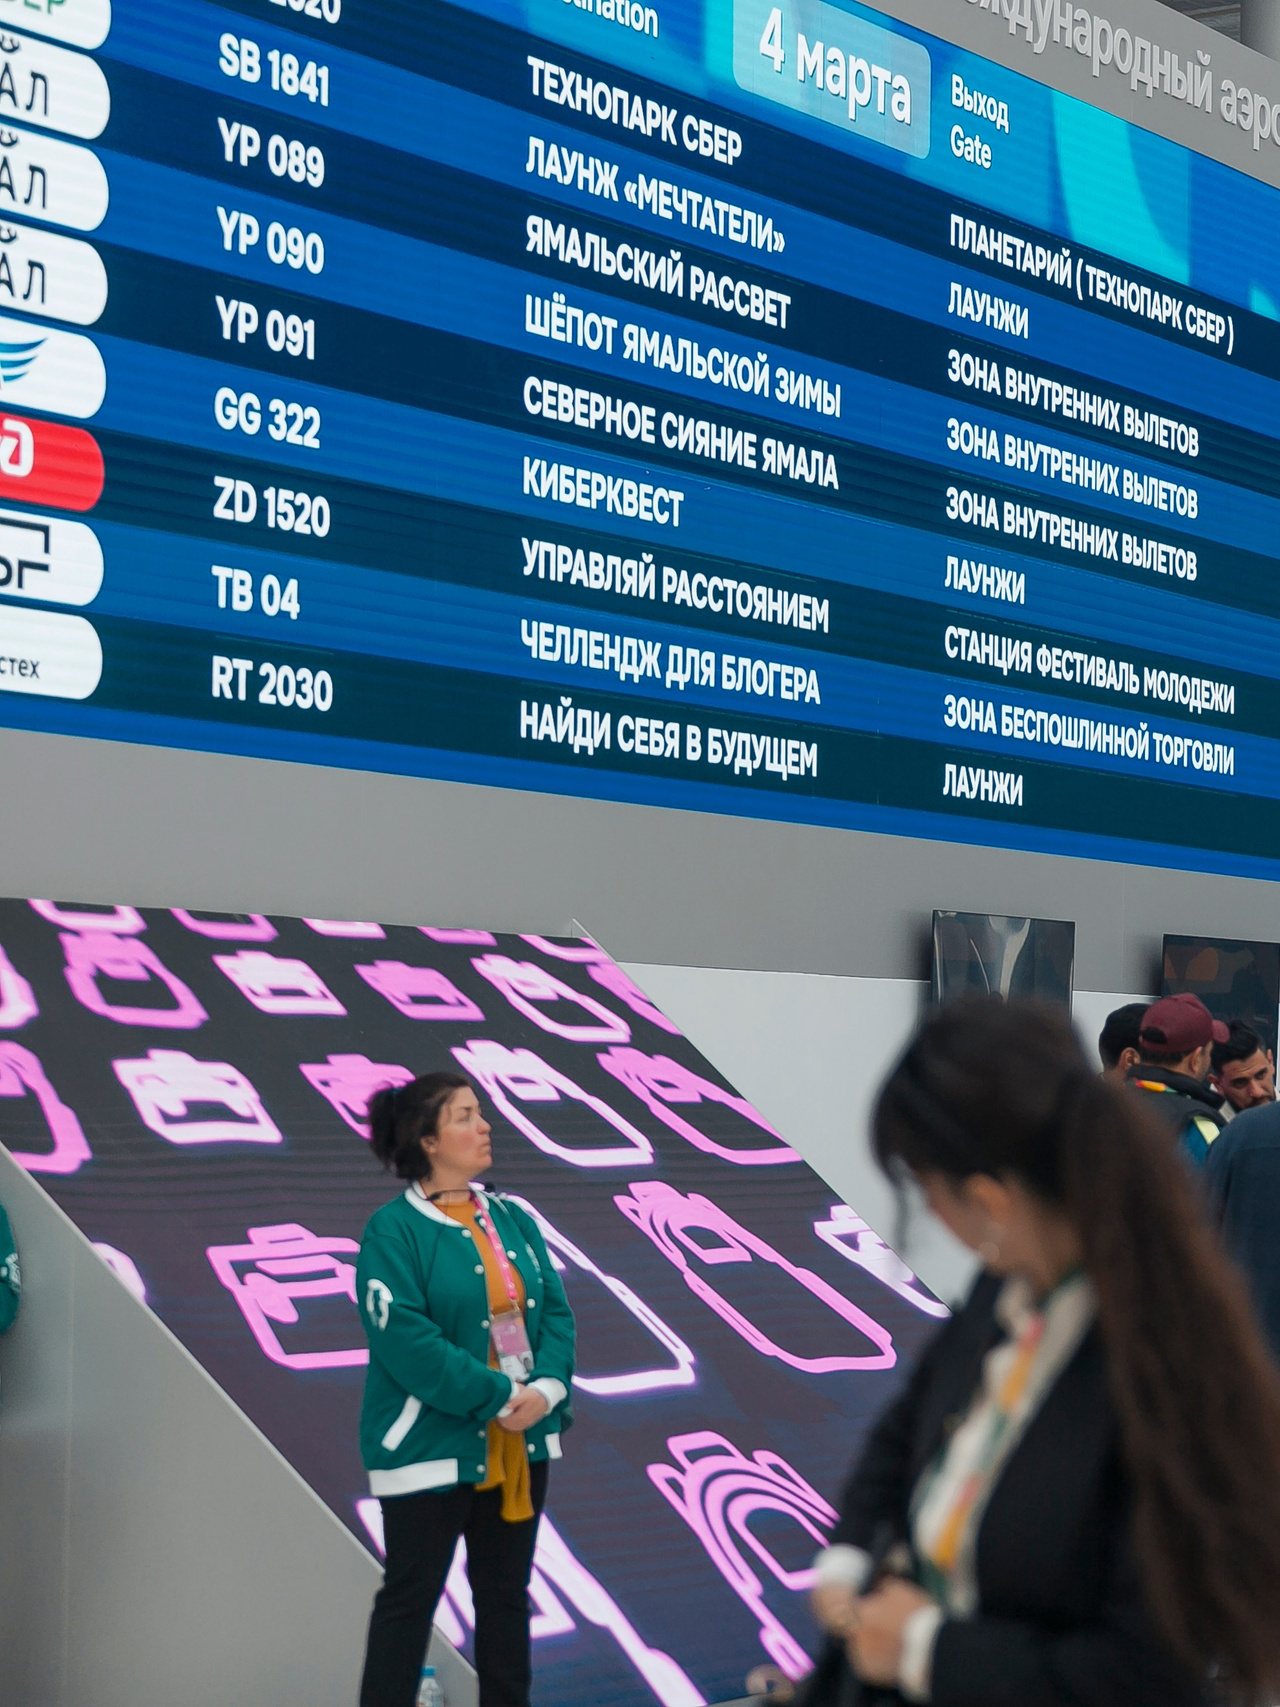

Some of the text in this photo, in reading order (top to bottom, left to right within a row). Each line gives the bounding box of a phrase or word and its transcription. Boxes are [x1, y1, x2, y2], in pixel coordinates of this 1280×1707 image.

[220, 34, 328, 105] SB 1841
[759, 8, 912, 125] 4 марта
[528, 56, 741, 165] ТЕХНОПАРК СБЕР
[951, 74, 1009, 133] Выход
[219, 118, 324, 187] YP 089
[950, 125, 992, 169] Gate
[527, 137, 785, 252] ЛАУНЖ «МЕЧТАТЕЛИ»
[218, 207, 323, 273] YP 090
[527, 216, 790, 328] ЯМАЛЬСКИЙ РАССВЕТ
[951, 214, 1071, 288] ПЛАНЕТАРИЙ
[216, 296, 314, 359] YP 091
[949, 283, 1028, 338] ЛАУНЖИ
[526, 293, 840, 417] ШЁПОТ ЯМАЛЬСКОЙ ЗИМЫ
[215, 388, 320, 448] GG 322
[524, 377, 838, 489] СЕВЕРНОЕ СИЯНИЕ ЯМАЛА
[948, 350, 1198, 456] ЗОНА ВНУТРЕННИХ ВЫЛЕТОВ
[214, 476, 330, 536] ZD 1520
[524, 457, 683, 526] КИБЕРКВЕСТ
[947, 487, 1196, 580] ЗОНА ВНУТРЕННИХ ВЫЛЕТОВ
[212, 566, 299, 619] TB 04
[522, 538, 828, 632] УПРАВЛЯЙ РАССТОЯНИЕМ
[945, 556, 1024, 604] ЛАУНЖИ
[213, 656, 332, 711] RT 2030
[522, 620, 820, 704] ЧЕЛЛЕНДЖ ДЛЯ БЛОГЕРА
[945, 626, 1234, 714] СТАНЦИЯ ФЕСТИВАЛЬ МОЛОДЕЖИ
[521, 697, 817, 780] НАЙДИ СЕБЯ В БУДУЩЕМ
[944, 695, 1233, 775] ЗОНА БЕСПОШЛИННОЙ ТОРГОВЛИ
[943, 764, 1022, 805] ЛАУНЖИ
